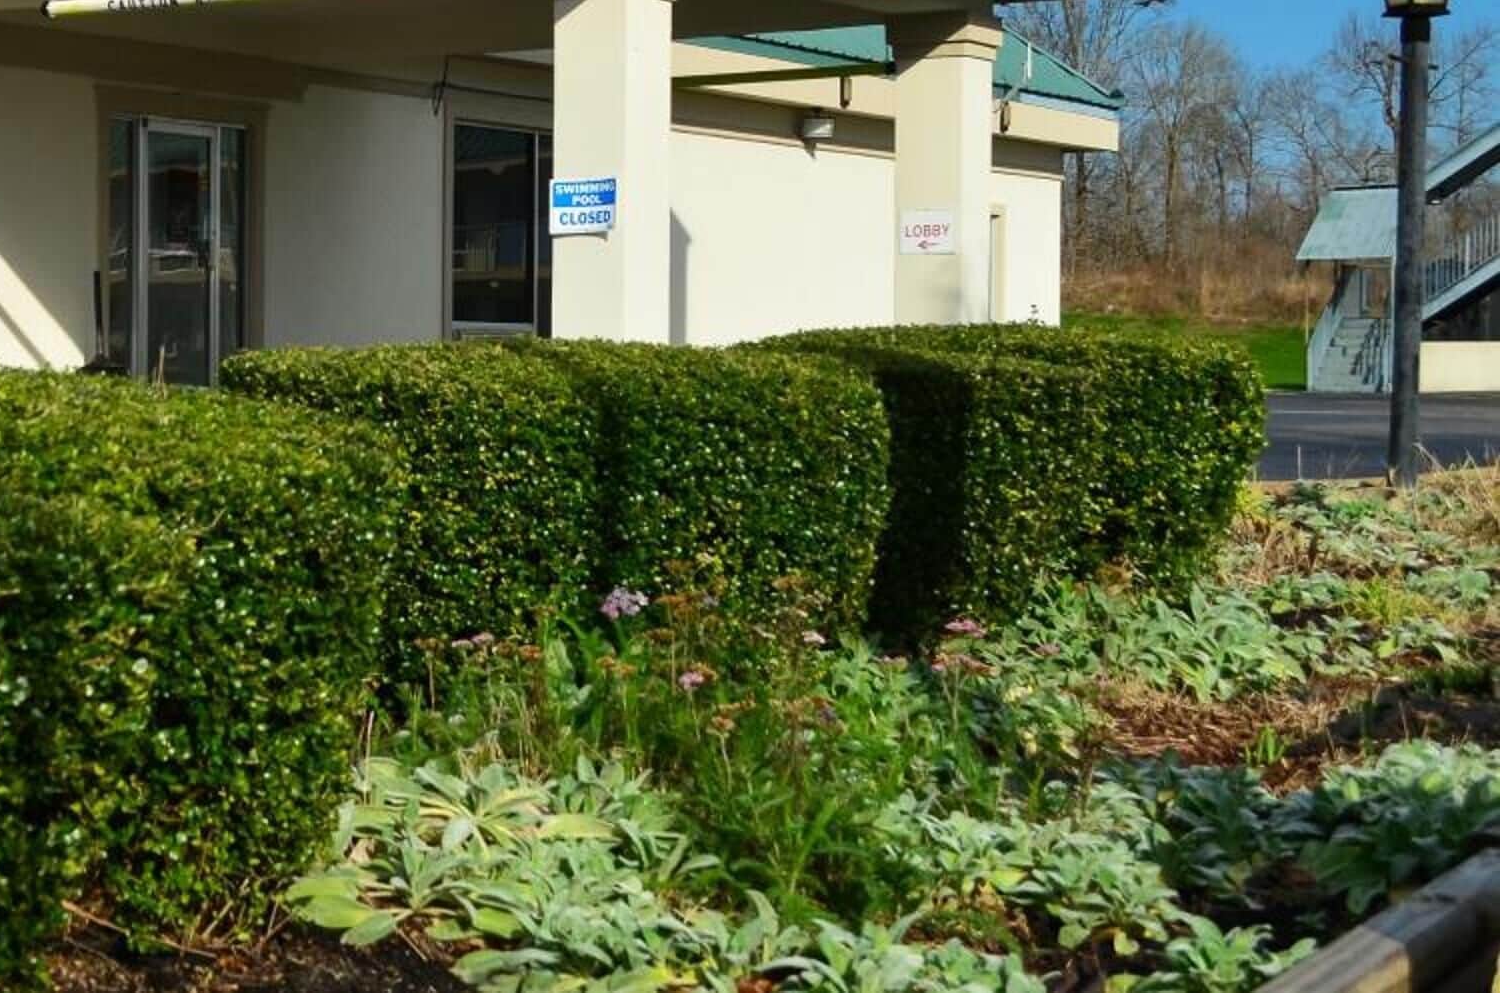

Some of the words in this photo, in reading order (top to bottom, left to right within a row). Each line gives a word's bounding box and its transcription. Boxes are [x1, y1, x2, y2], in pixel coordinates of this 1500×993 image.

[571, 194, 603, 206] POOL
[559, 210, 611, 225] CLOSED
[904, 224, 949, 238] LOBBY
